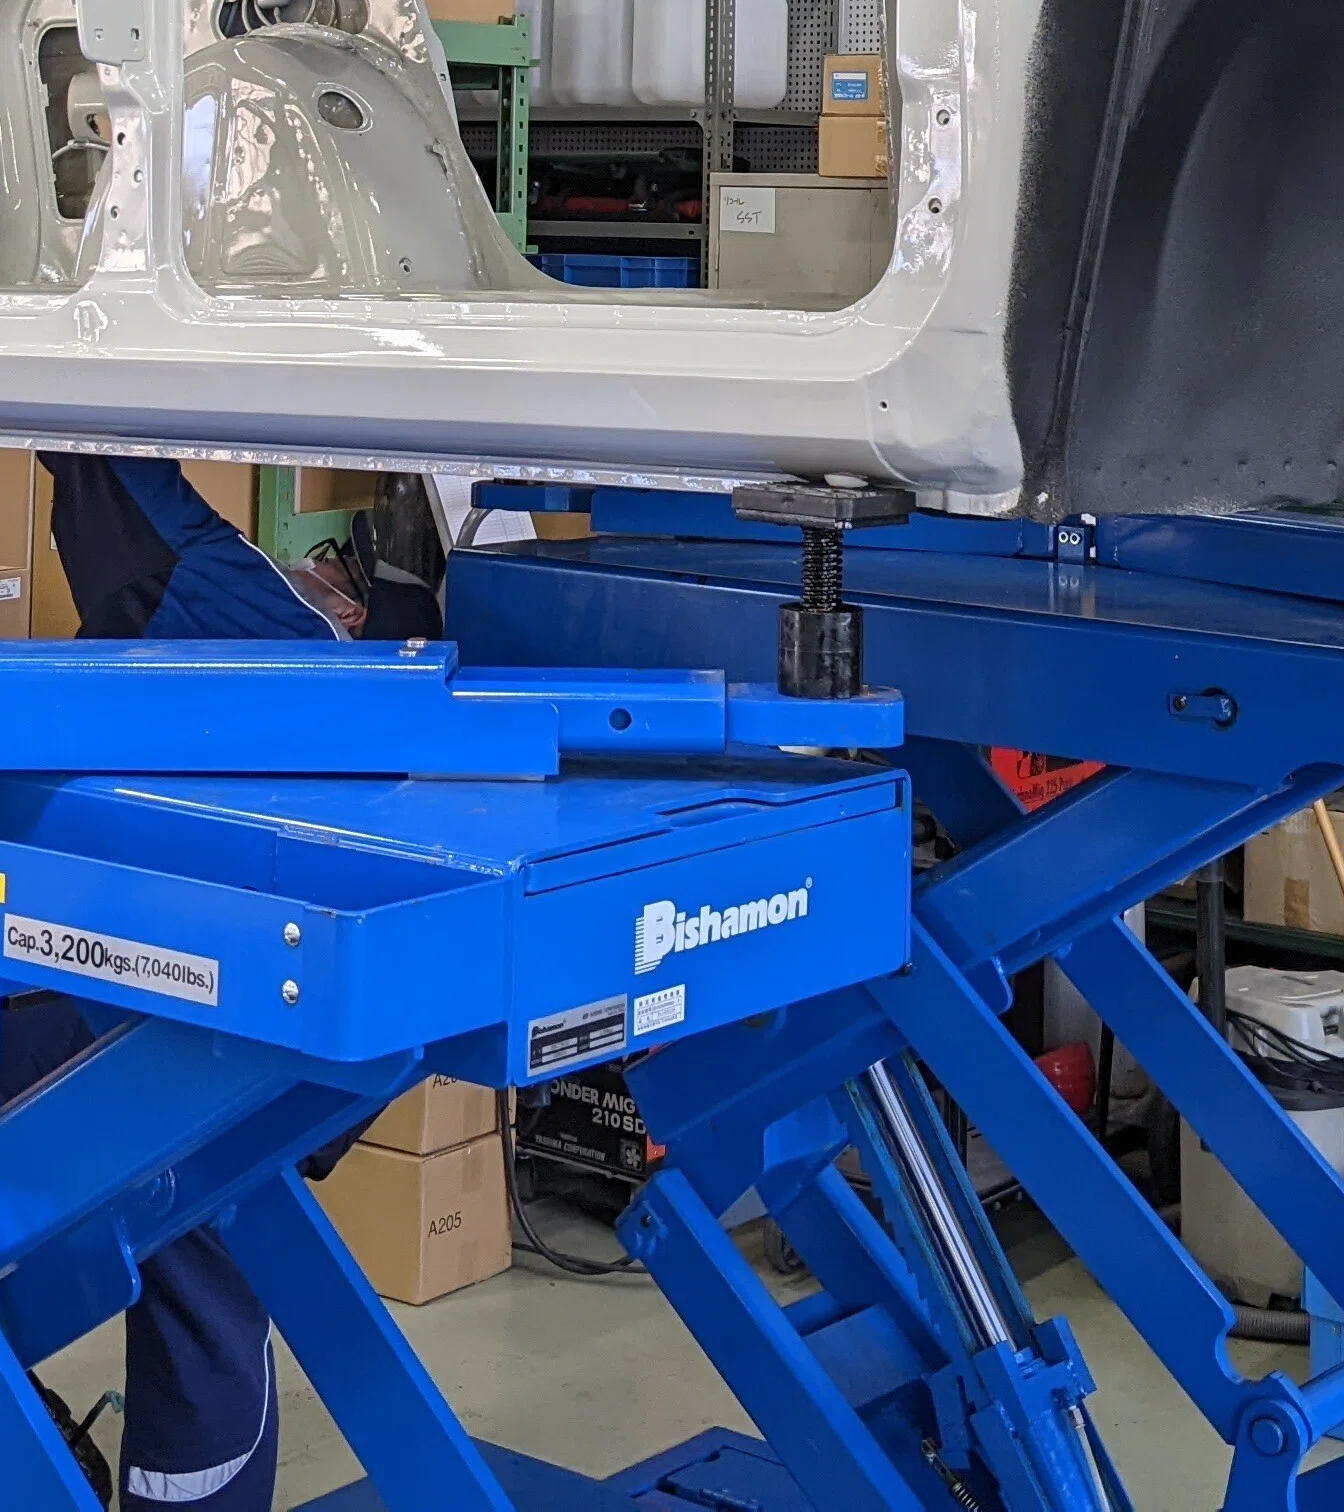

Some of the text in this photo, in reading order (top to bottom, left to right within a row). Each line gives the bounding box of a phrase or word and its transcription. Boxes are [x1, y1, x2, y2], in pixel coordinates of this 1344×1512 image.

[736, 210, 762, 225] SST
[635, 886, 809, 975] Bishamon
[551, 1079, 636, 1114] ONDER MIG
[428, 1210, 462, 1238] A205
